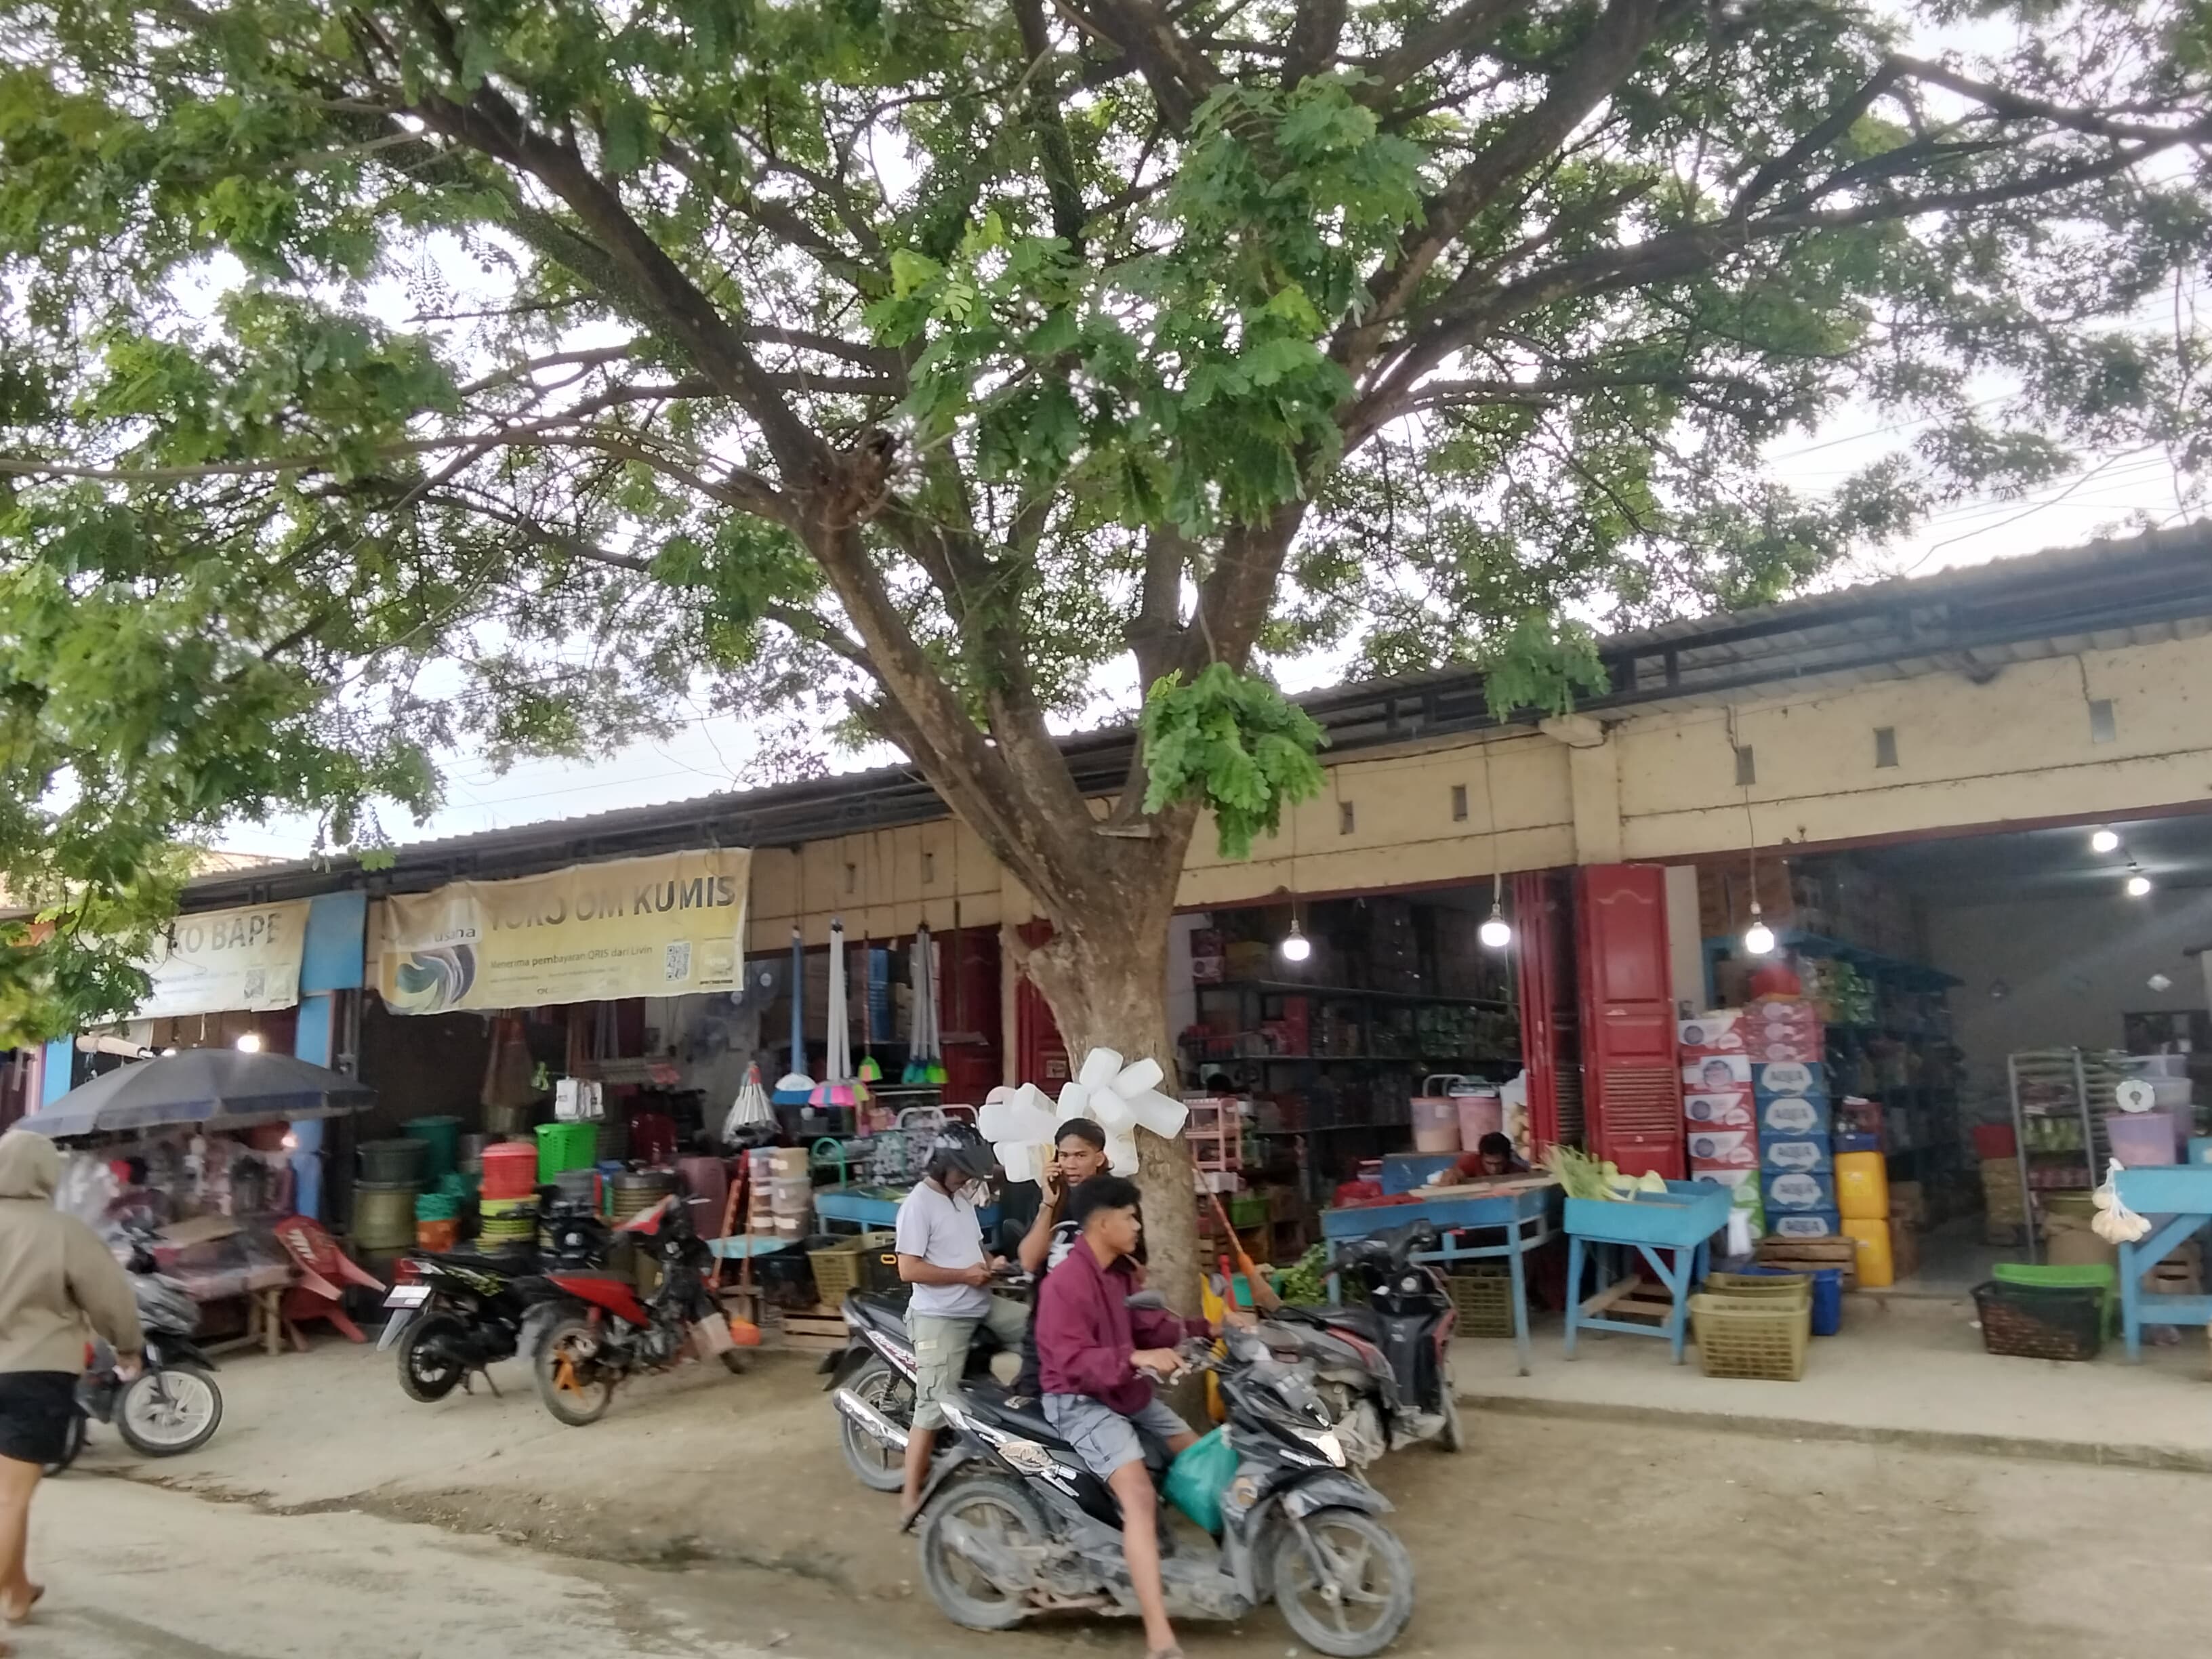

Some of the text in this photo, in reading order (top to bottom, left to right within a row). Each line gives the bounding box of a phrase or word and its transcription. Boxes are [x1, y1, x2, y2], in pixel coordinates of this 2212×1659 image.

[576, 890, 623, 922] OM
[634, 875, 736, 916] KUMIS
[211, 913, 282, 950] BAPE
[532, 951, 586, 968] pembayaran
[588, 949, 609, 960] QRIS
